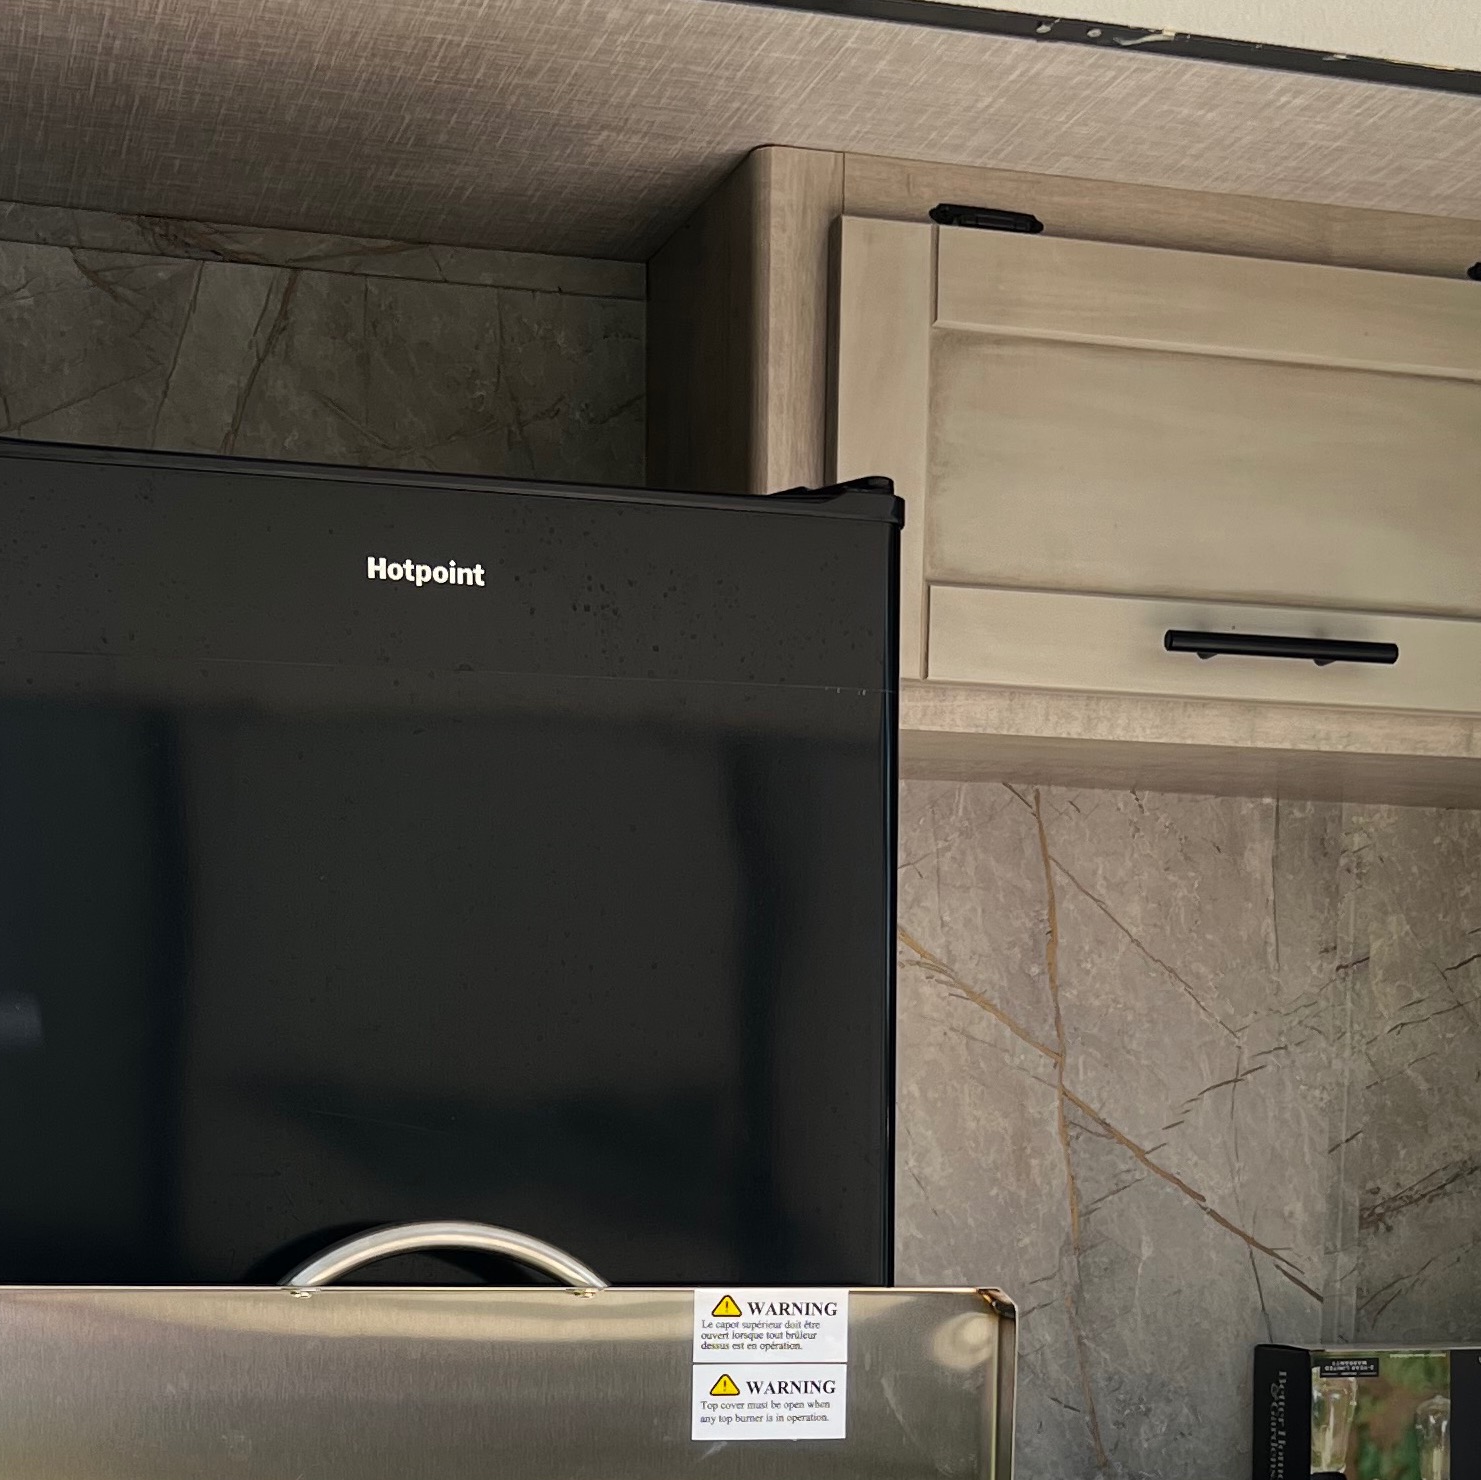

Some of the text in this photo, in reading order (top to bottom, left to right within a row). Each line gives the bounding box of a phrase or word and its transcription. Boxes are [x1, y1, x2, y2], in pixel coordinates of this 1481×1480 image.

[367, 556, 485, 586] Hotpoint
[747, 1302, 838, 1316] WARNING
[702, 1320, 820, 1330] Le capot supérieur doit être
[732, 1331, 763, 1341] lorsque
[760, 1342, 802, 1351] opération.
[746, 1380, 836, 1395] WARNING
[1277, 1370, 1287, 1426] Better
[701, 1401, 718, 1410] Top
[747, 1401, 768, 1409] must
[784, 1402, 804, 1410] open
[807, 1400, 830, 1408] when
[700, 1413, 829, 1425] any top burner is in operation.
